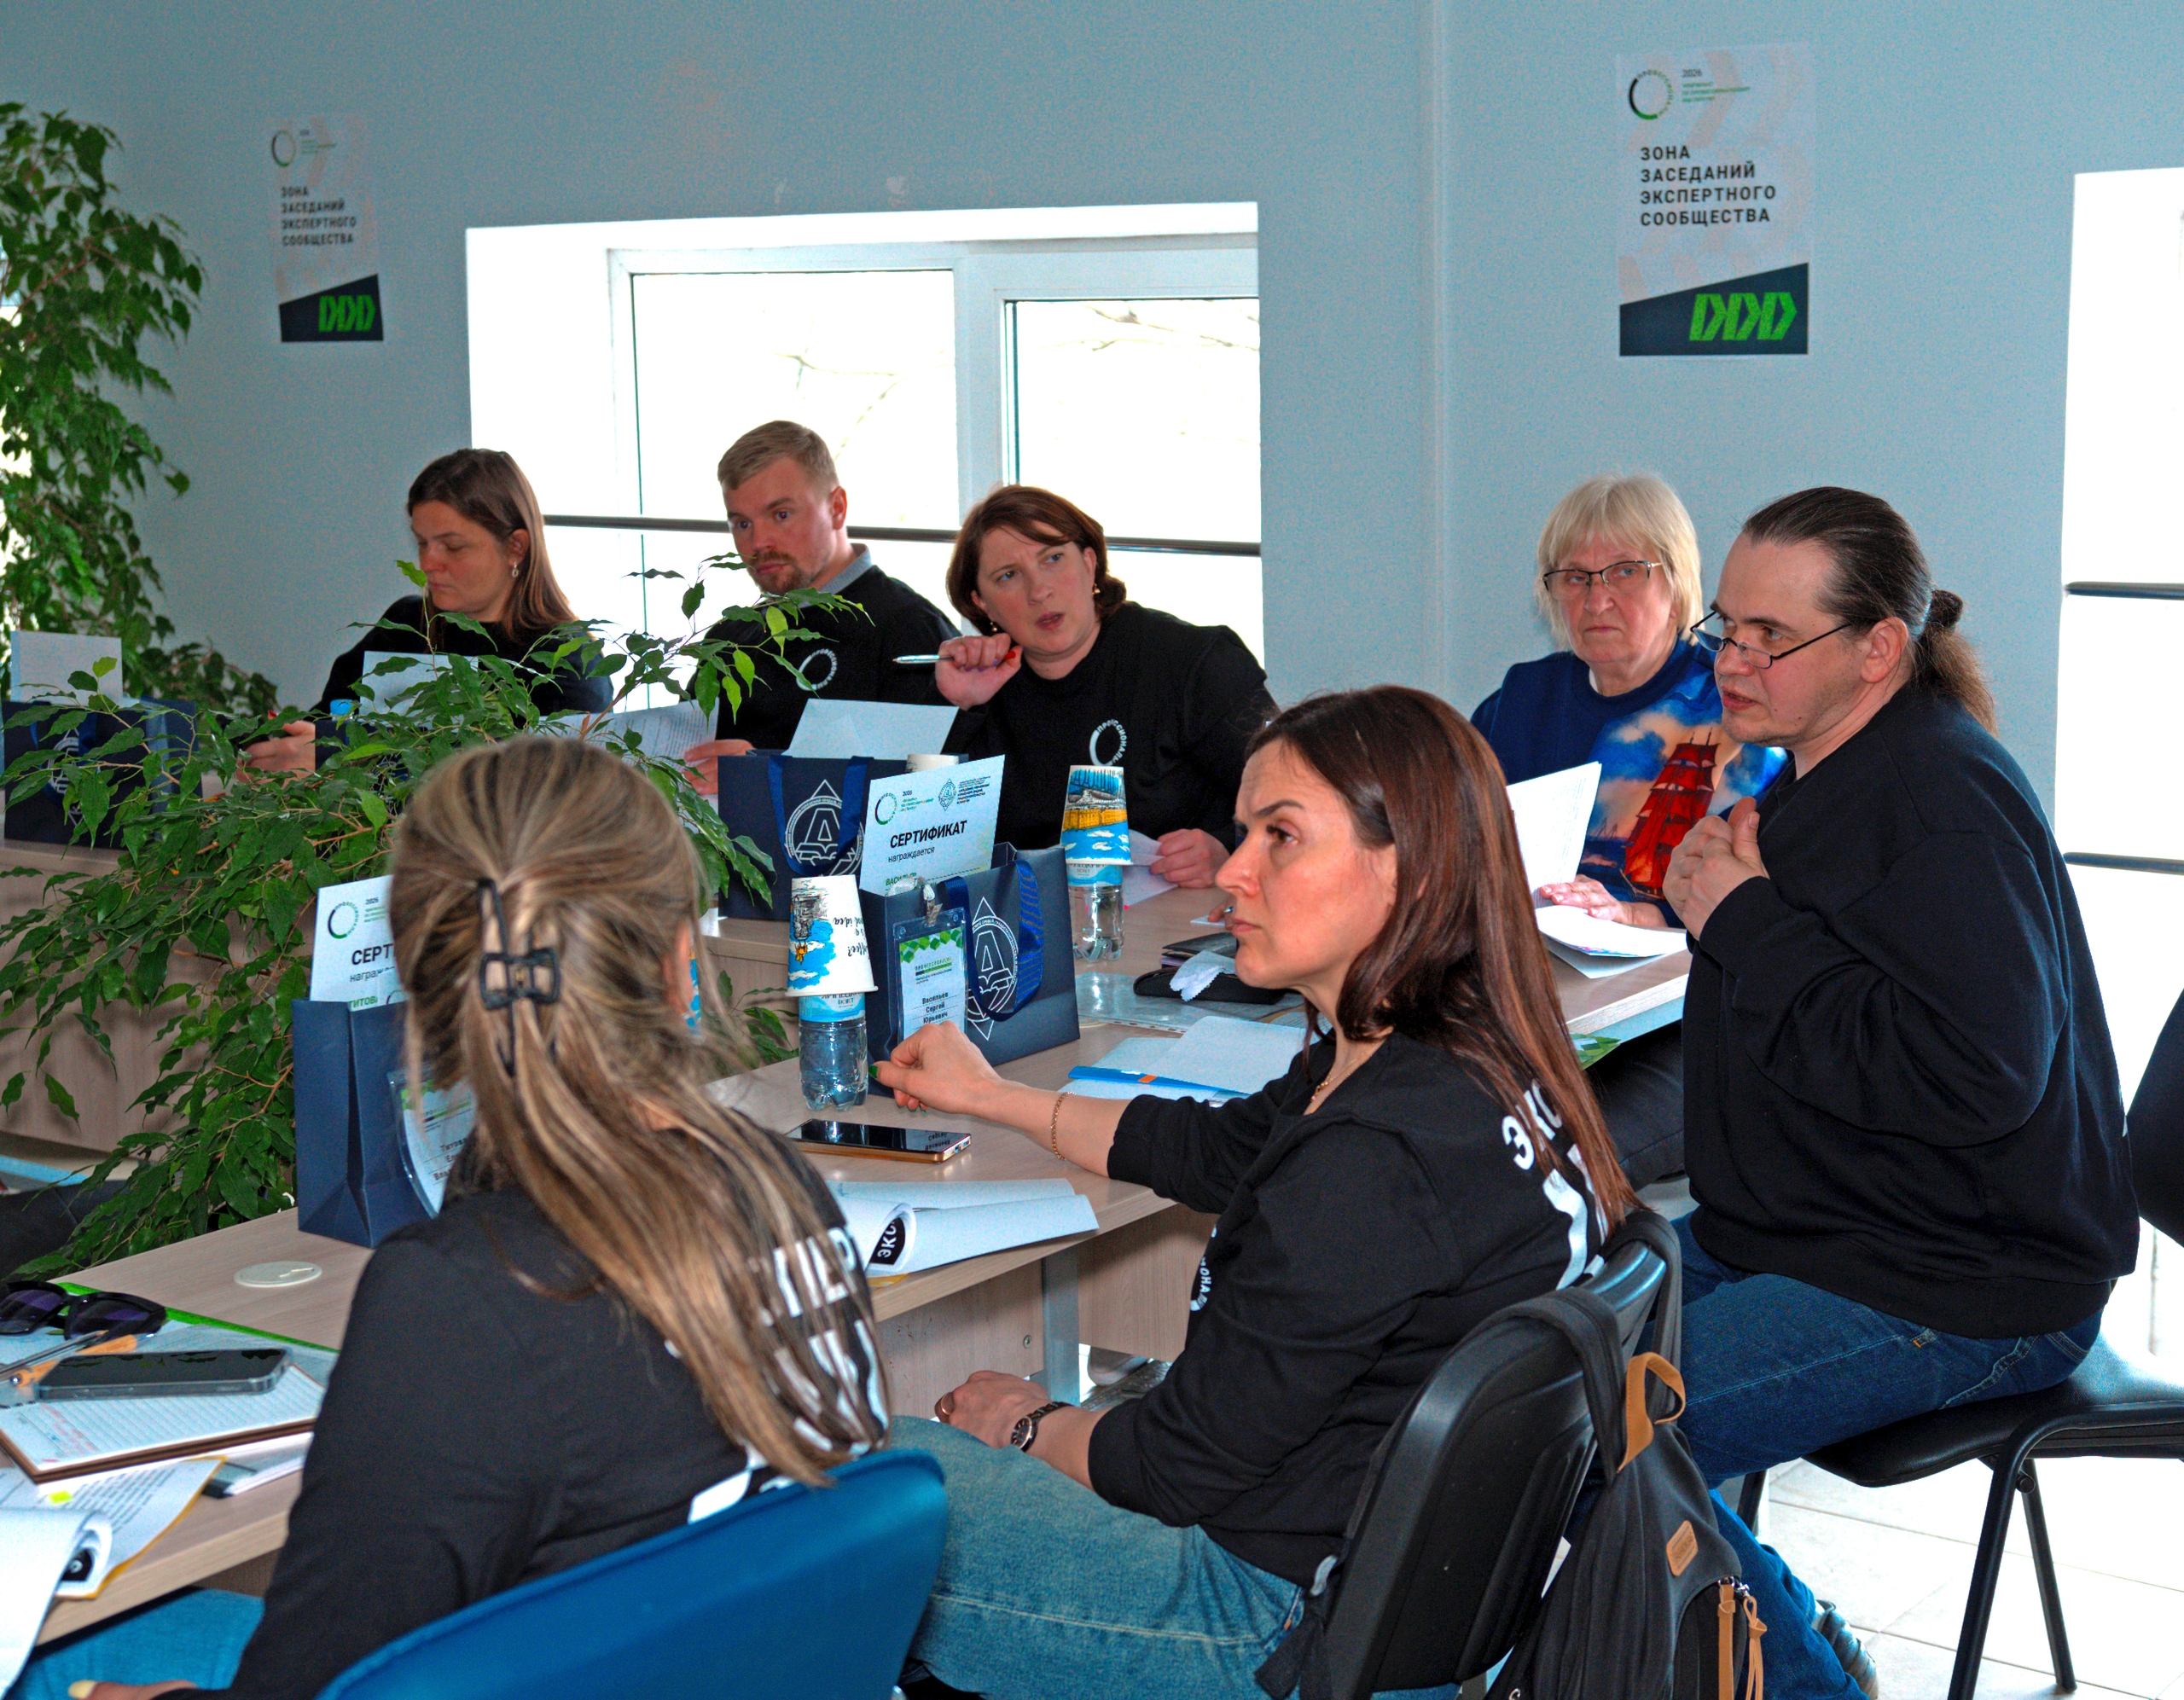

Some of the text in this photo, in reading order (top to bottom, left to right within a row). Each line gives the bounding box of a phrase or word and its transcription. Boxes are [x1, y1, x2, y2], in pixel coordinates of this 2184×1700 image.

[1641, 145, 1691, 161] ЗОНА
[1641, 160, 1756, 184] ЗАСЕДАНИЙ
[281, 186, 309, 198] ЗОНА
[1640, 185, 1776, 205] ЭКСПЕРТНОГО
[282, 198, 345, 213] ЗАСЕДАНИЙ
[282, 216, 357, 230] ЭКСПЕРТНОГО
[1641, 208, 1770, 227] СООБЩЕСТВА
[282, 233, 354, 247] СООБЩЕСТВА
[890, 820, 967, 849] СЕРТИФИКАТ
[888, 846, 935, 863] награждается
[833, 917, 852, 928] idea
[351, 943, 395, 966] СЕРТ
[922, 992, 949, 1005] Васильев
[926, 1001, 945, 1013] Сергей
[923, 1012, 948, 1024] Юрьевич
[877, 1221, 897, 1258] ЭКС
